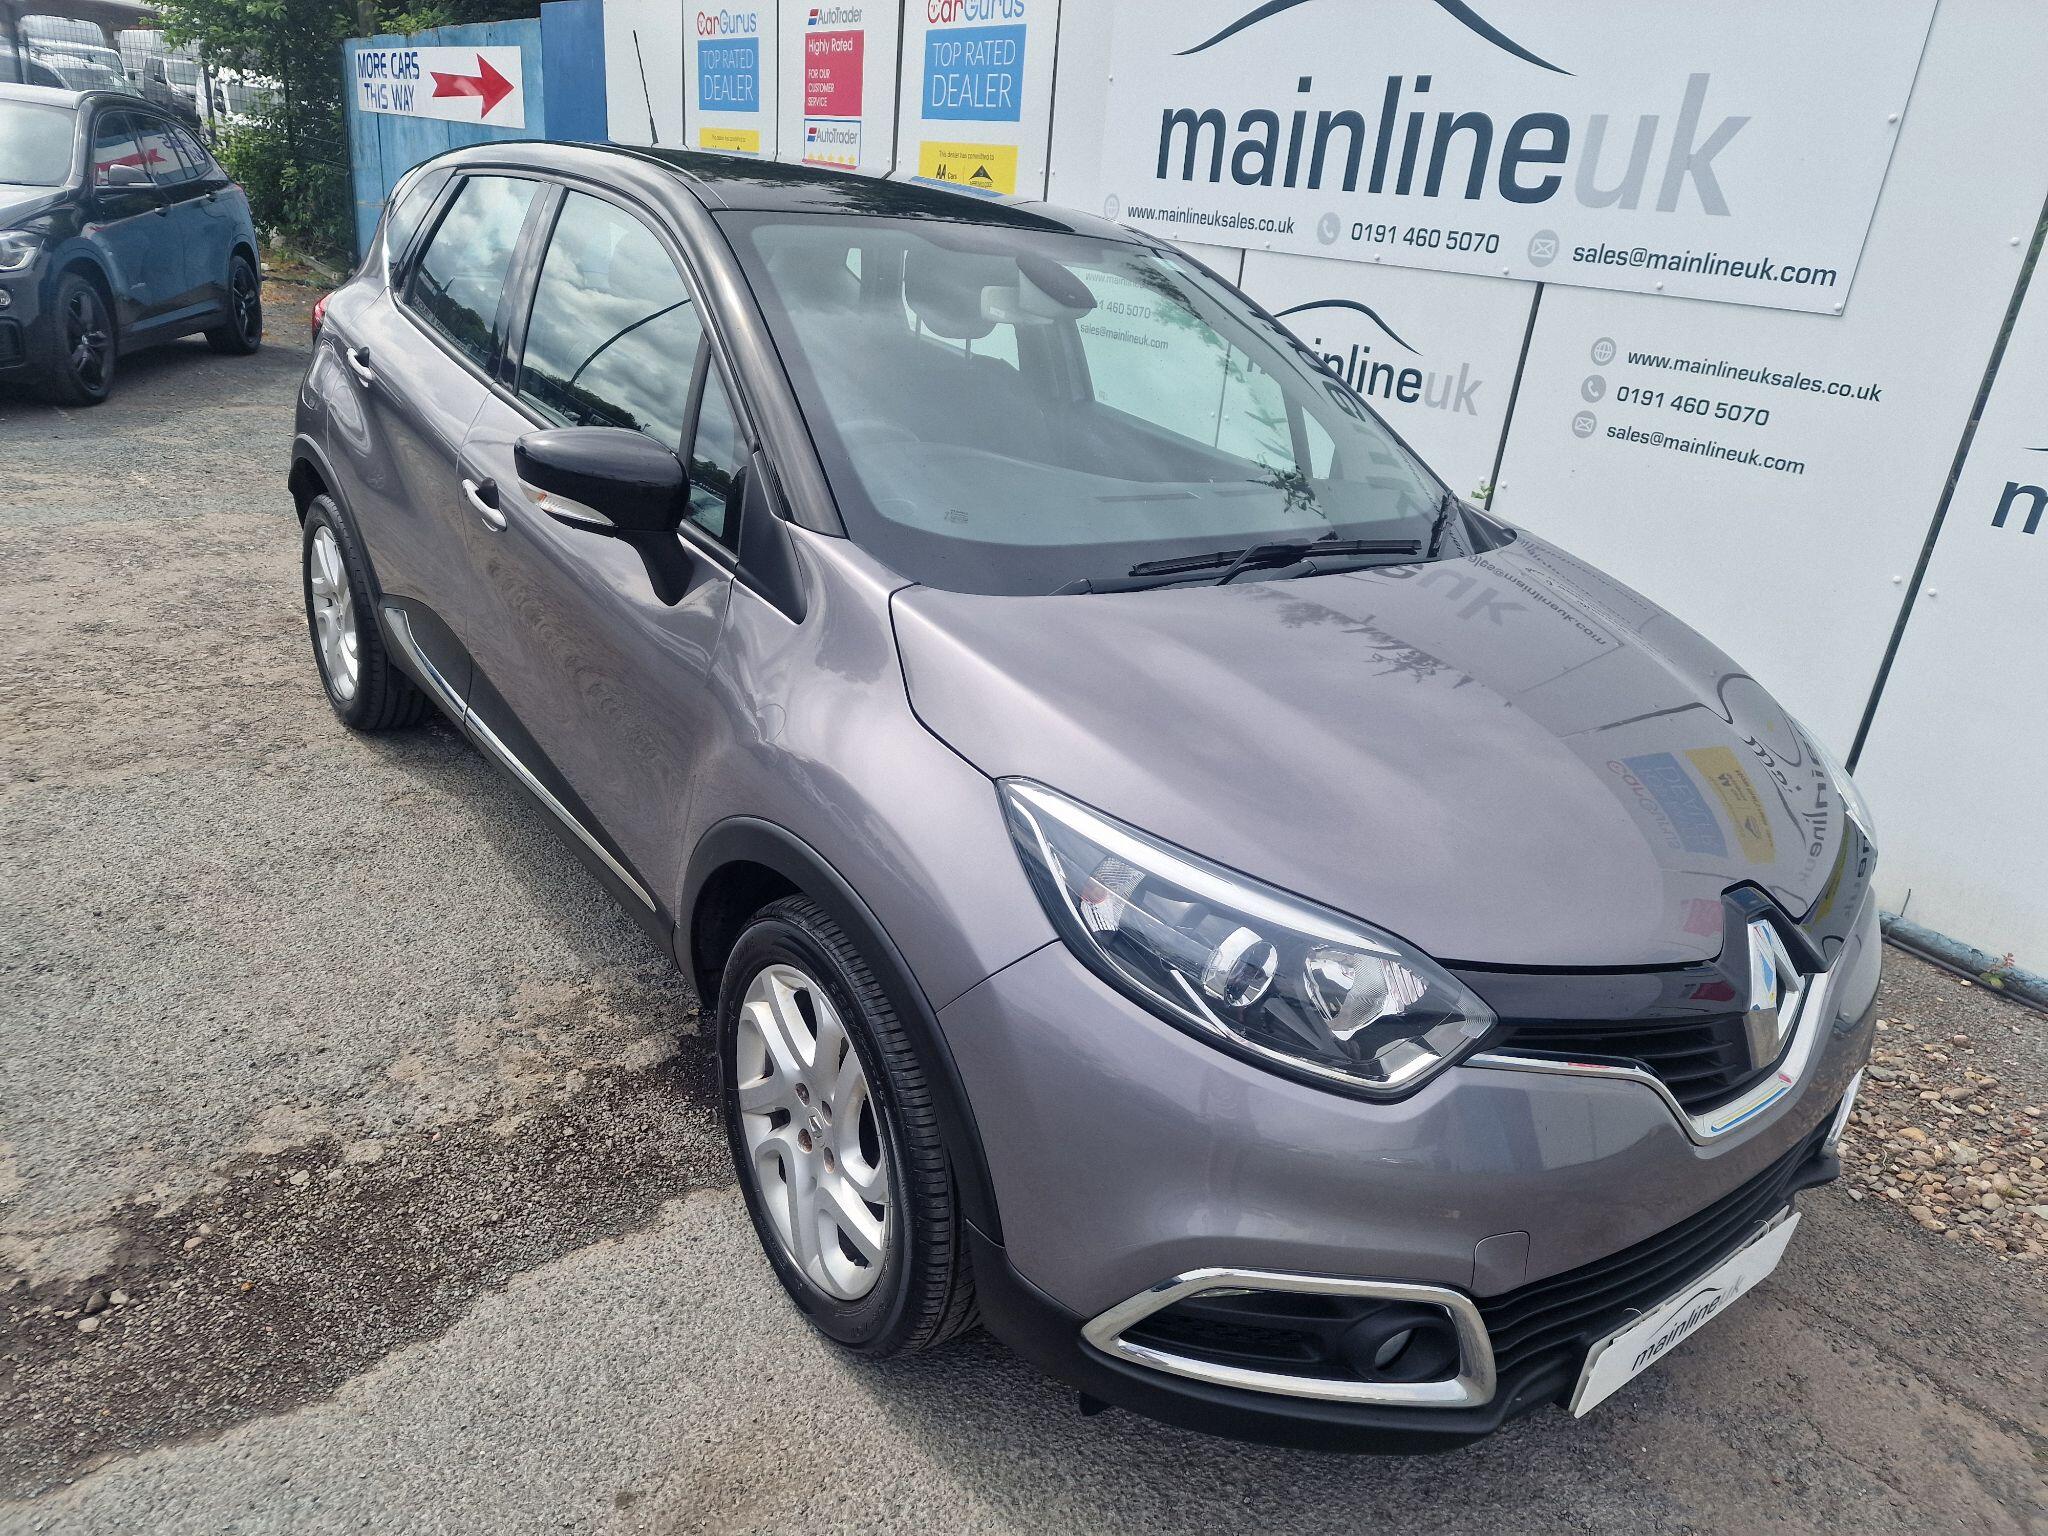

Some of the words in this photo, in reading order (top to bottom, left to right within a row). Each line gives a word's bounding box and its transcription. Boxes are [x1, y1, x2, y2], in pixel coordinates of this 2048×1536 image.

[696, 9, 757, 35] CarGurus
[818, 6, 862, 25] AutoTrader
[702, 49, 720, 69] TOP
[722, 49, 753, 69] RATED
[808, 39, 830, 55] Highly
[832, 37, 853, 52] Rated
[932, 42, 961, 67] TOP
[965, 39, 1016, 66] RATED
[357, 53, 387, 79] MORE
[390, 52, 420, 80] CARS
[808, 69, 819, 79] FOR
[819, 69, 831, 79] OUR
[364, 82, 388, 109] THIS
[391, 84, 415, 112] WAY
[704, 74, 754, 101] DEALER
[808, 82, 834, 93] CUSTOMER
[808, 96, 828, 107] SERVICE
[932, 73, 1012, 108] DEALER
[816, 127, 858, 145] AutoTrader
[1156, 73, 1752, 217] mainlineuk
[1128, 204, 1295, 234] www.mainlineuksales.co.uk
[1351, 222, 1397, 244] 0191
[1403, 227, 1440, 249] 460
[1446, 230, 1499, 255] 5070
[1572, 243, 1838, 288] sales@mainlineuk.com
[1627, 350, 1882, 403] www.mainlineuksales.co.uk
[1616, 385, 1664, 409] 0191
[1670, 395, 1710, 416] 460
[1715, 402, 1770, 427] 5070
[1606, 423, 1805, 476] sales@mainlineuk.com
[1631, 1273, 1745, 1372] mainlineuk
